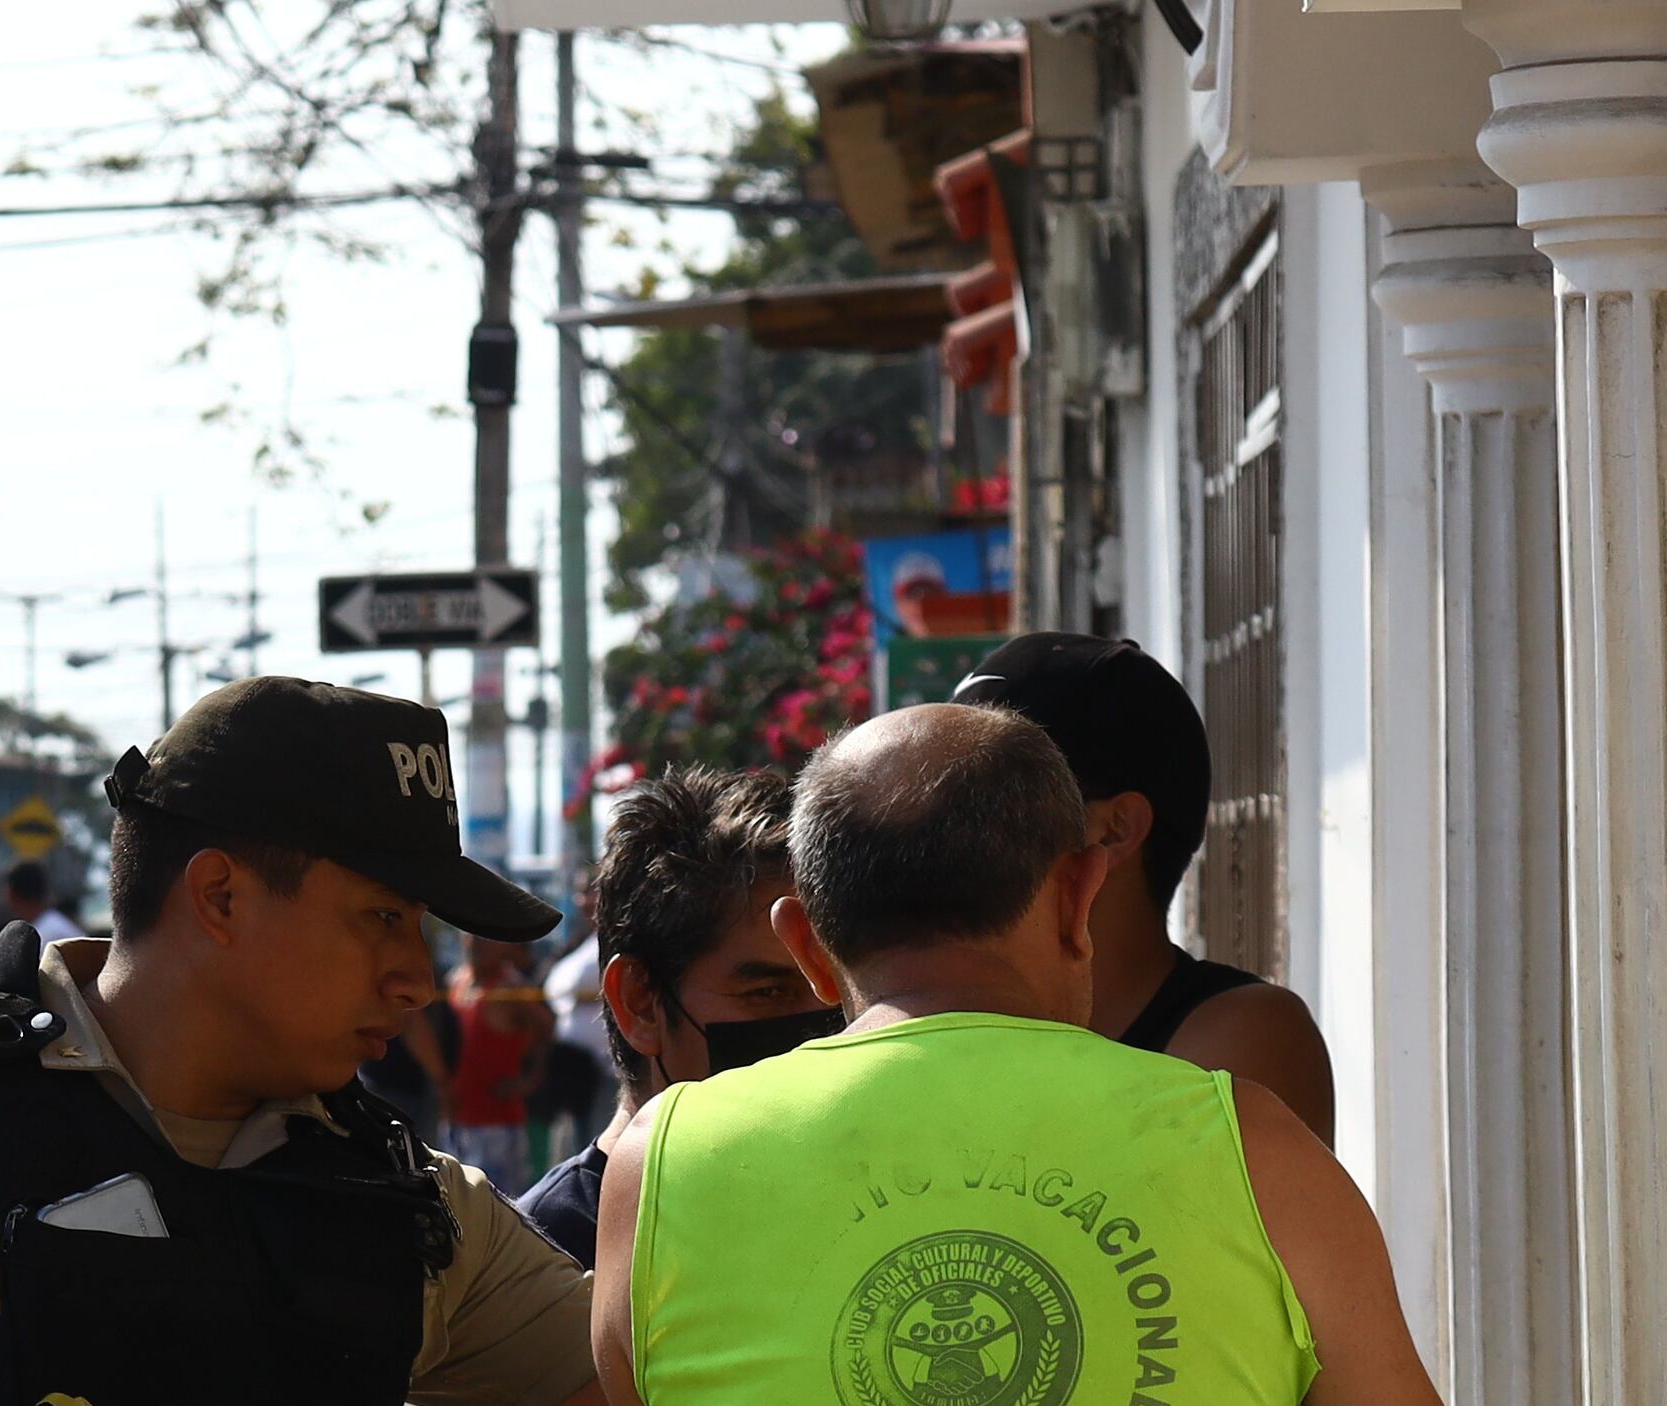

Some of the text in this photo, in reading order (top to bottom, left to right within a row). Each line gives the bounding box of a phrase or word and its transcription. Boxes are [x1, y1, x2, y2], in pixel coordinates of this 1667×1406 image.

[847, 1309, 871, 1349] CLUB
[912, 1243, 987, 1270] CULTURAL
[991, 1247, 1004, 1264] Y
[1001, 1253, 1067, 1327] DEPORTIVO
[897, 1262, 1004, 1301] DE OFICIALES
